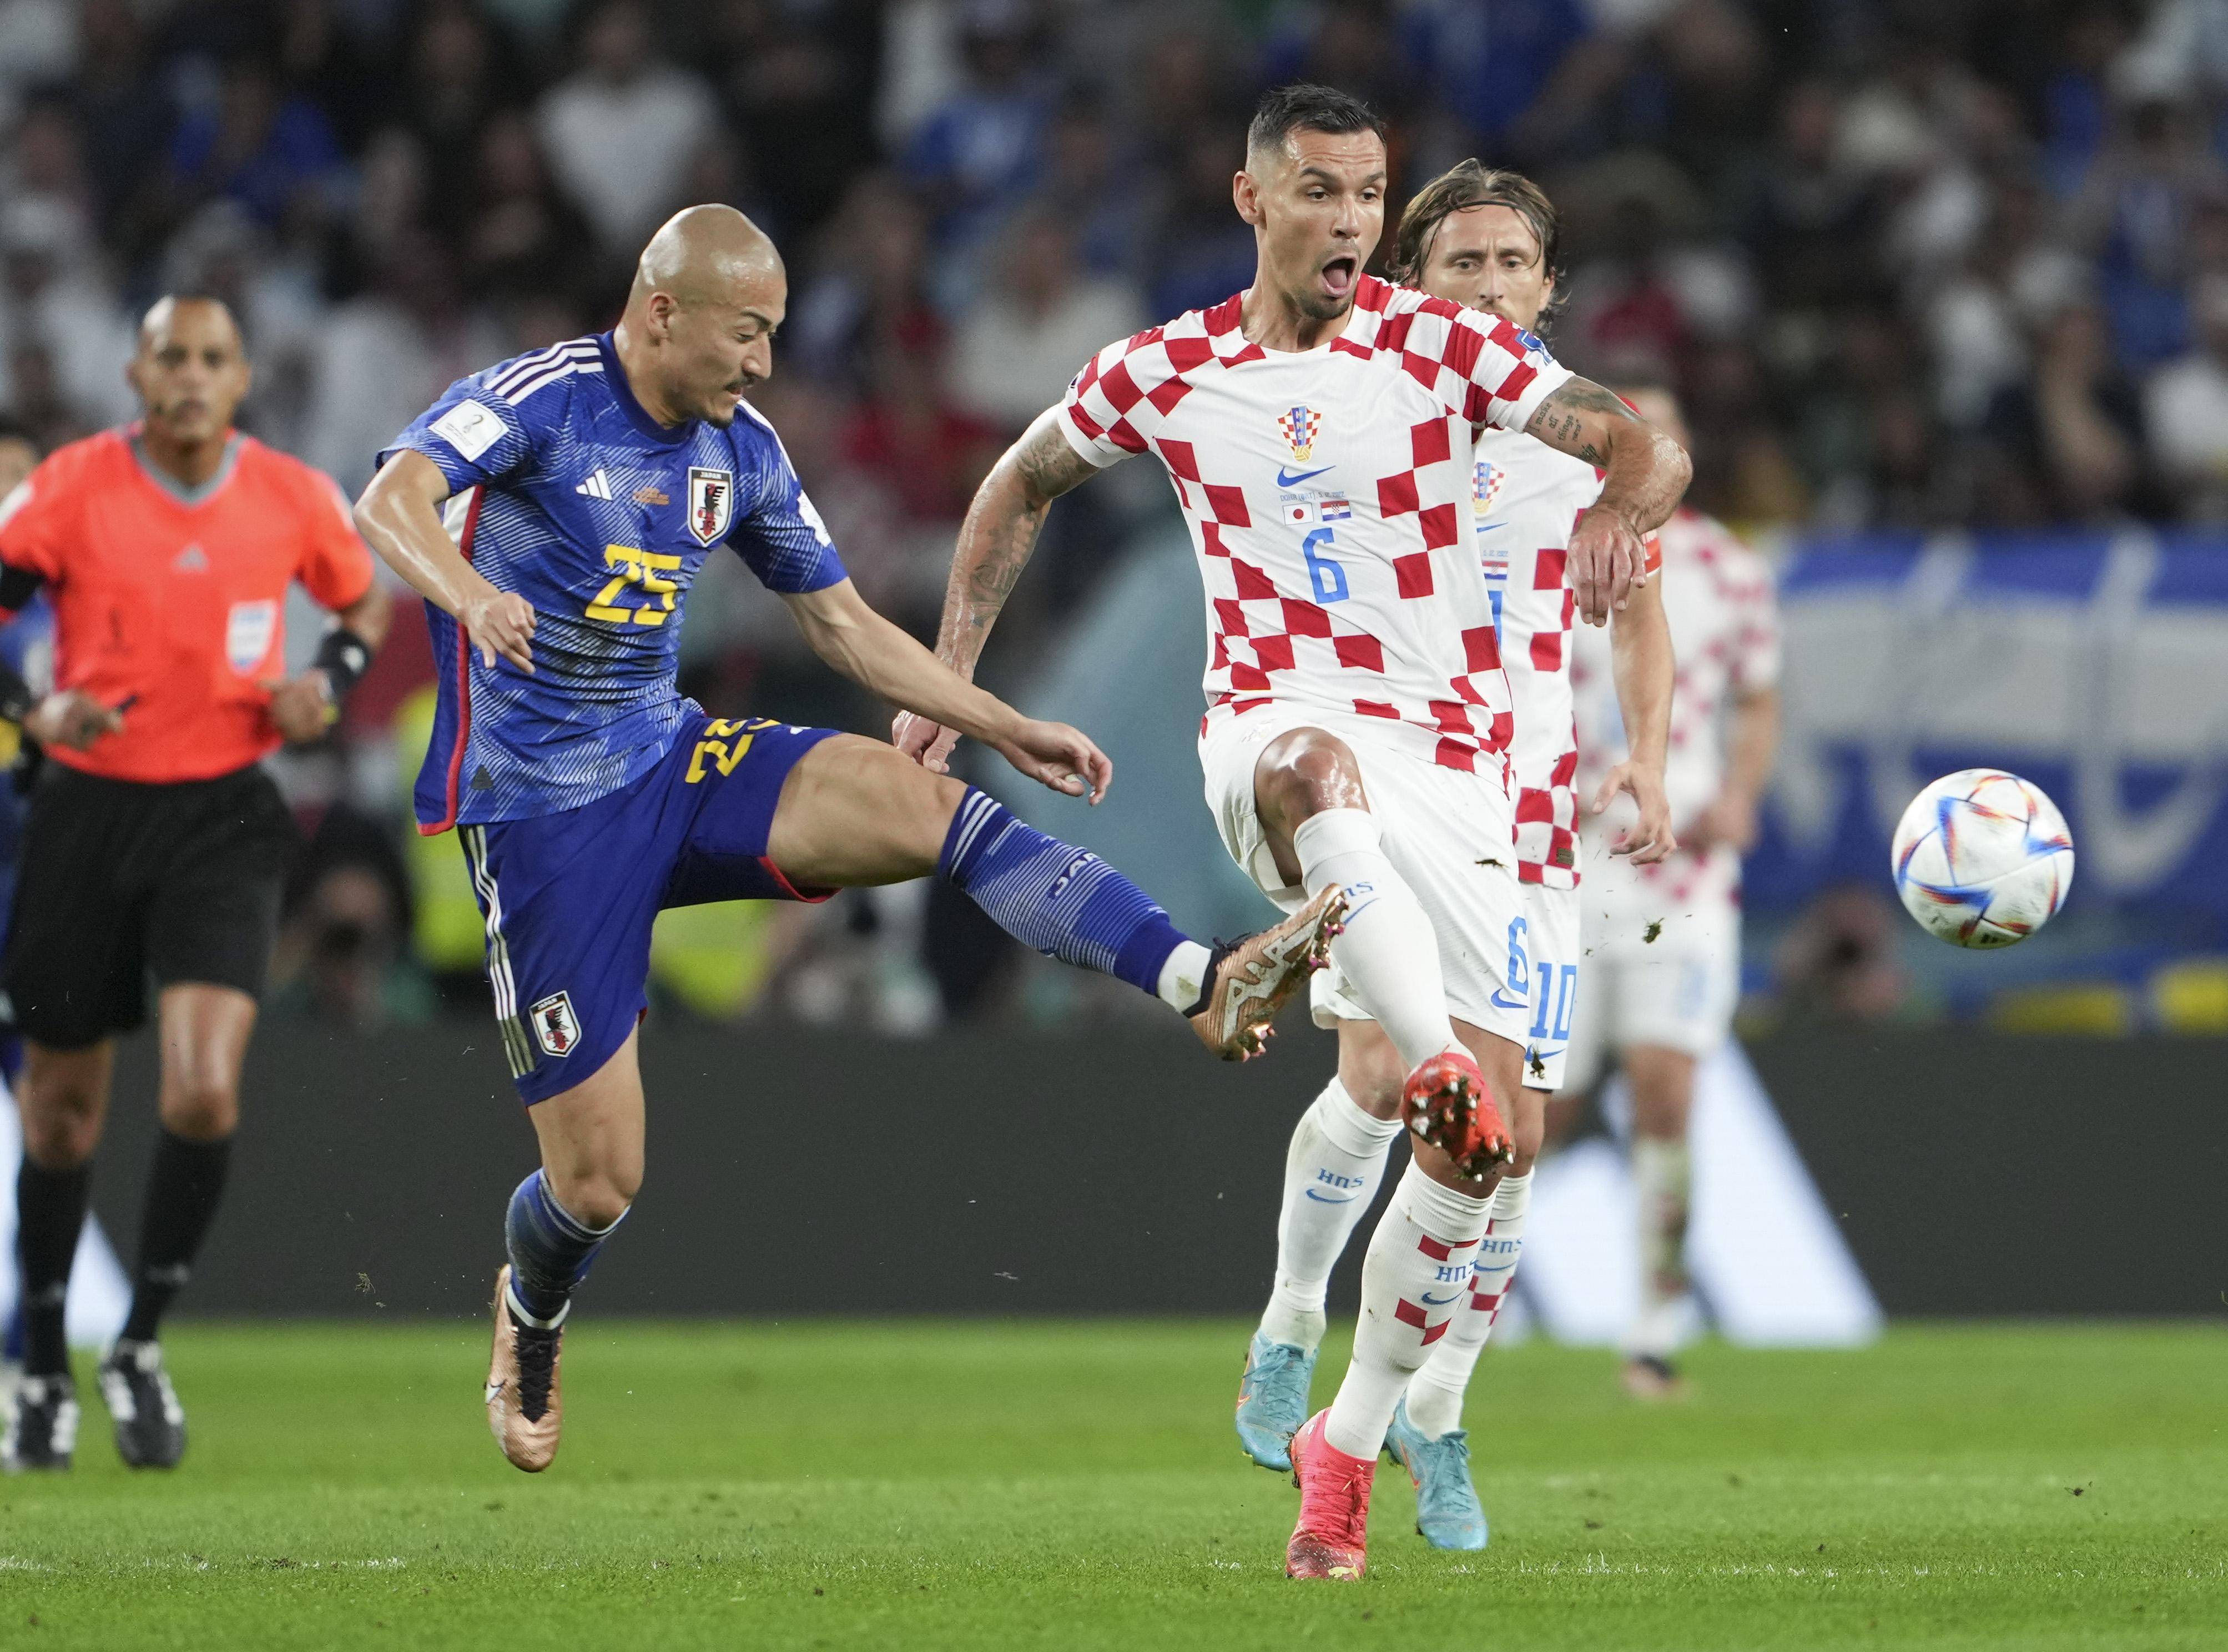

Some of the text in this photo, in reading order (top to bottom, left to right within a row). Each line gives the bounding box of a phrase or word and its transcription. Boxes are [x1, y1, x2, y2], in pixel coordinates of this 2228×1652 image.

[585, 543, 682, 626] 25
[1302, 527, 1349, 605] 6
[1508, 916, 1529, 996] 6
[1529, 962, 1577, 1040] 10
